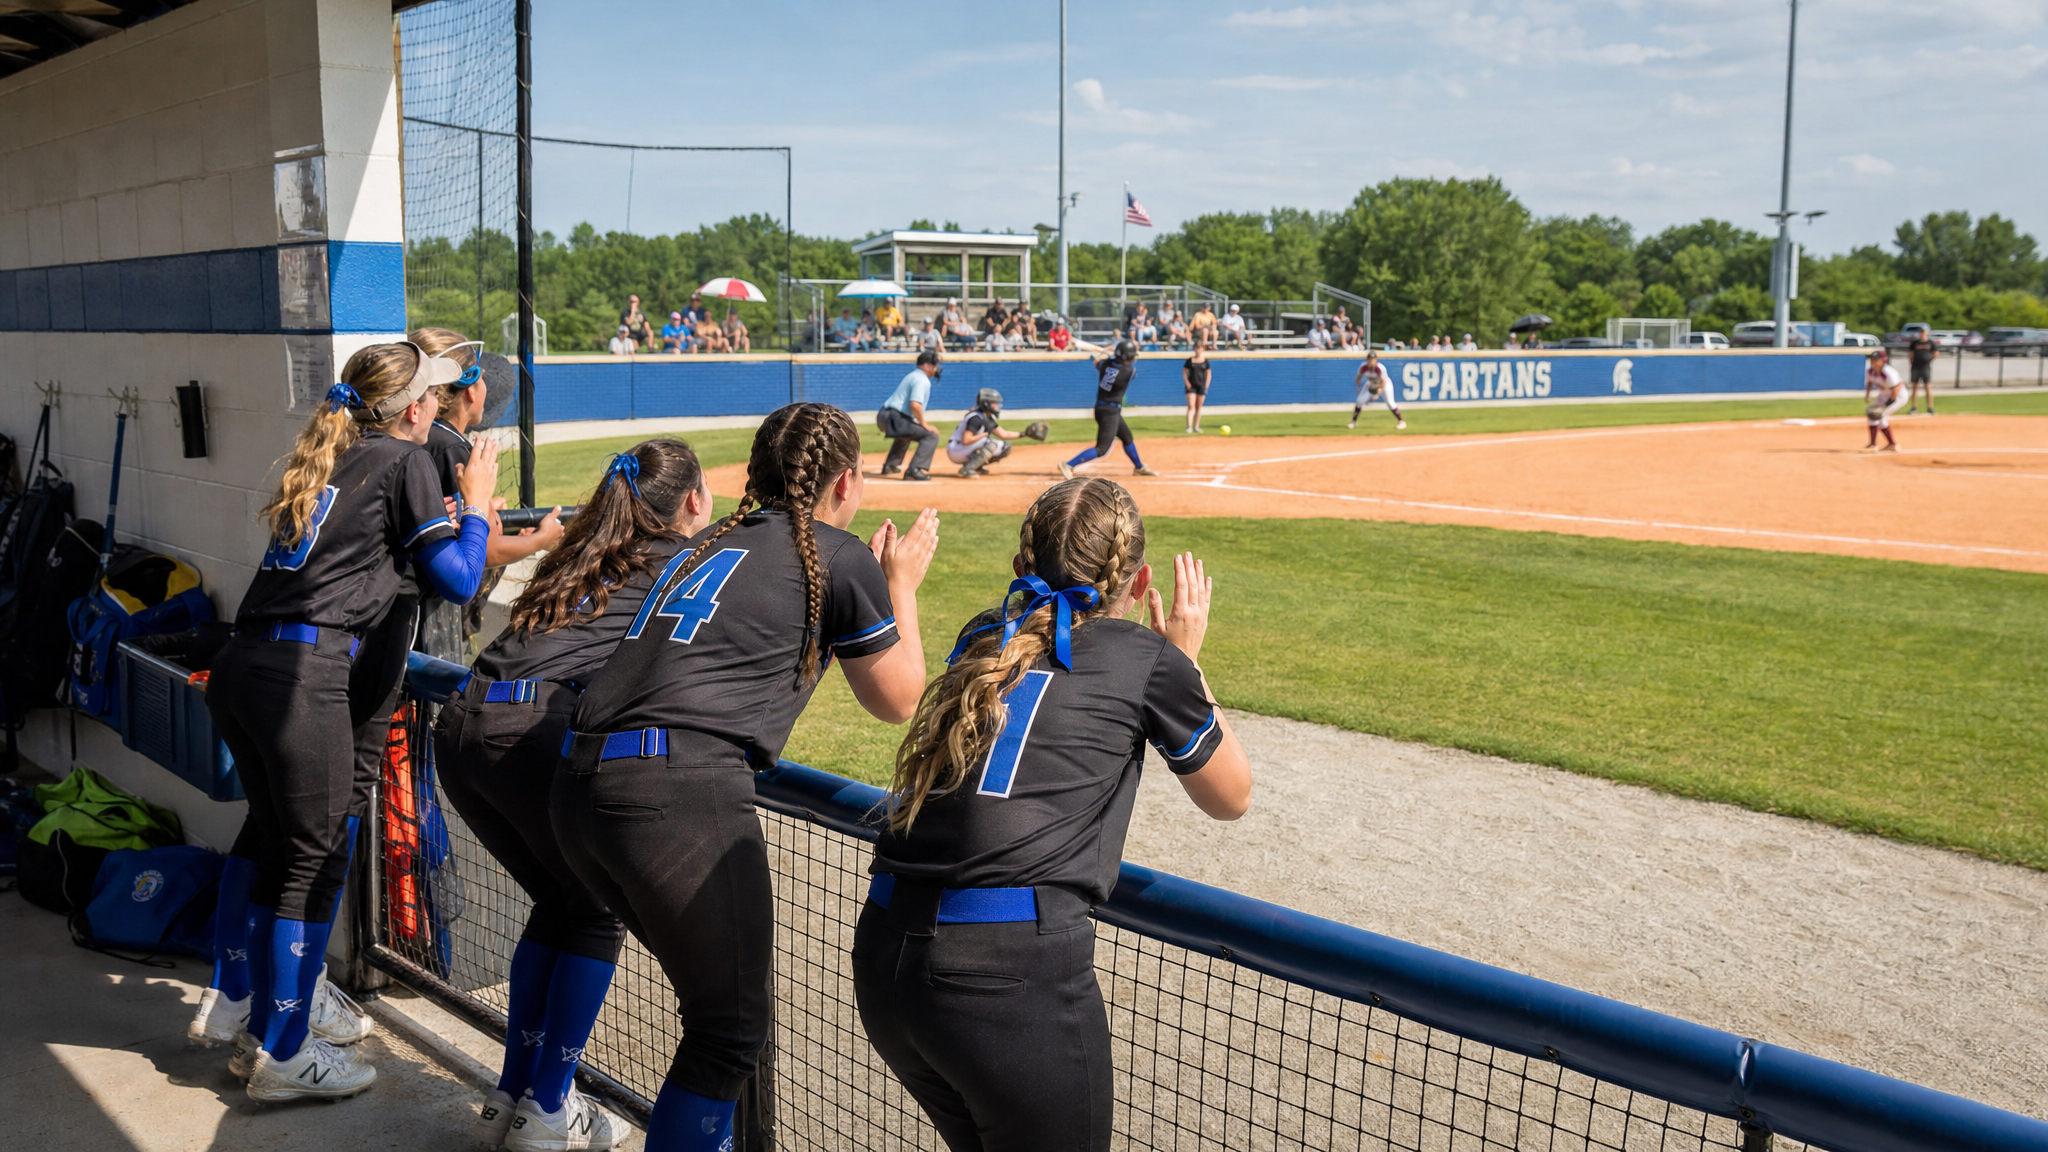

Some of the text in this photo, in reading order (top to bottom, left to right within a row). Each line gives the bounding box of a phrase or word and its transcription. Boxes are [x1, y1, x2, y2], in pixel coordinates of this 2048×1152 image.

[1100, 366, 1120, 392] 2
[1402, 361, 1552, 401] SPARTANS
[624, 547, 750, 645] 14
[298, 1061, 331, 1085] N
[511, 1114, 528, 1130] B
[567, 1111, 594, 1136] N
